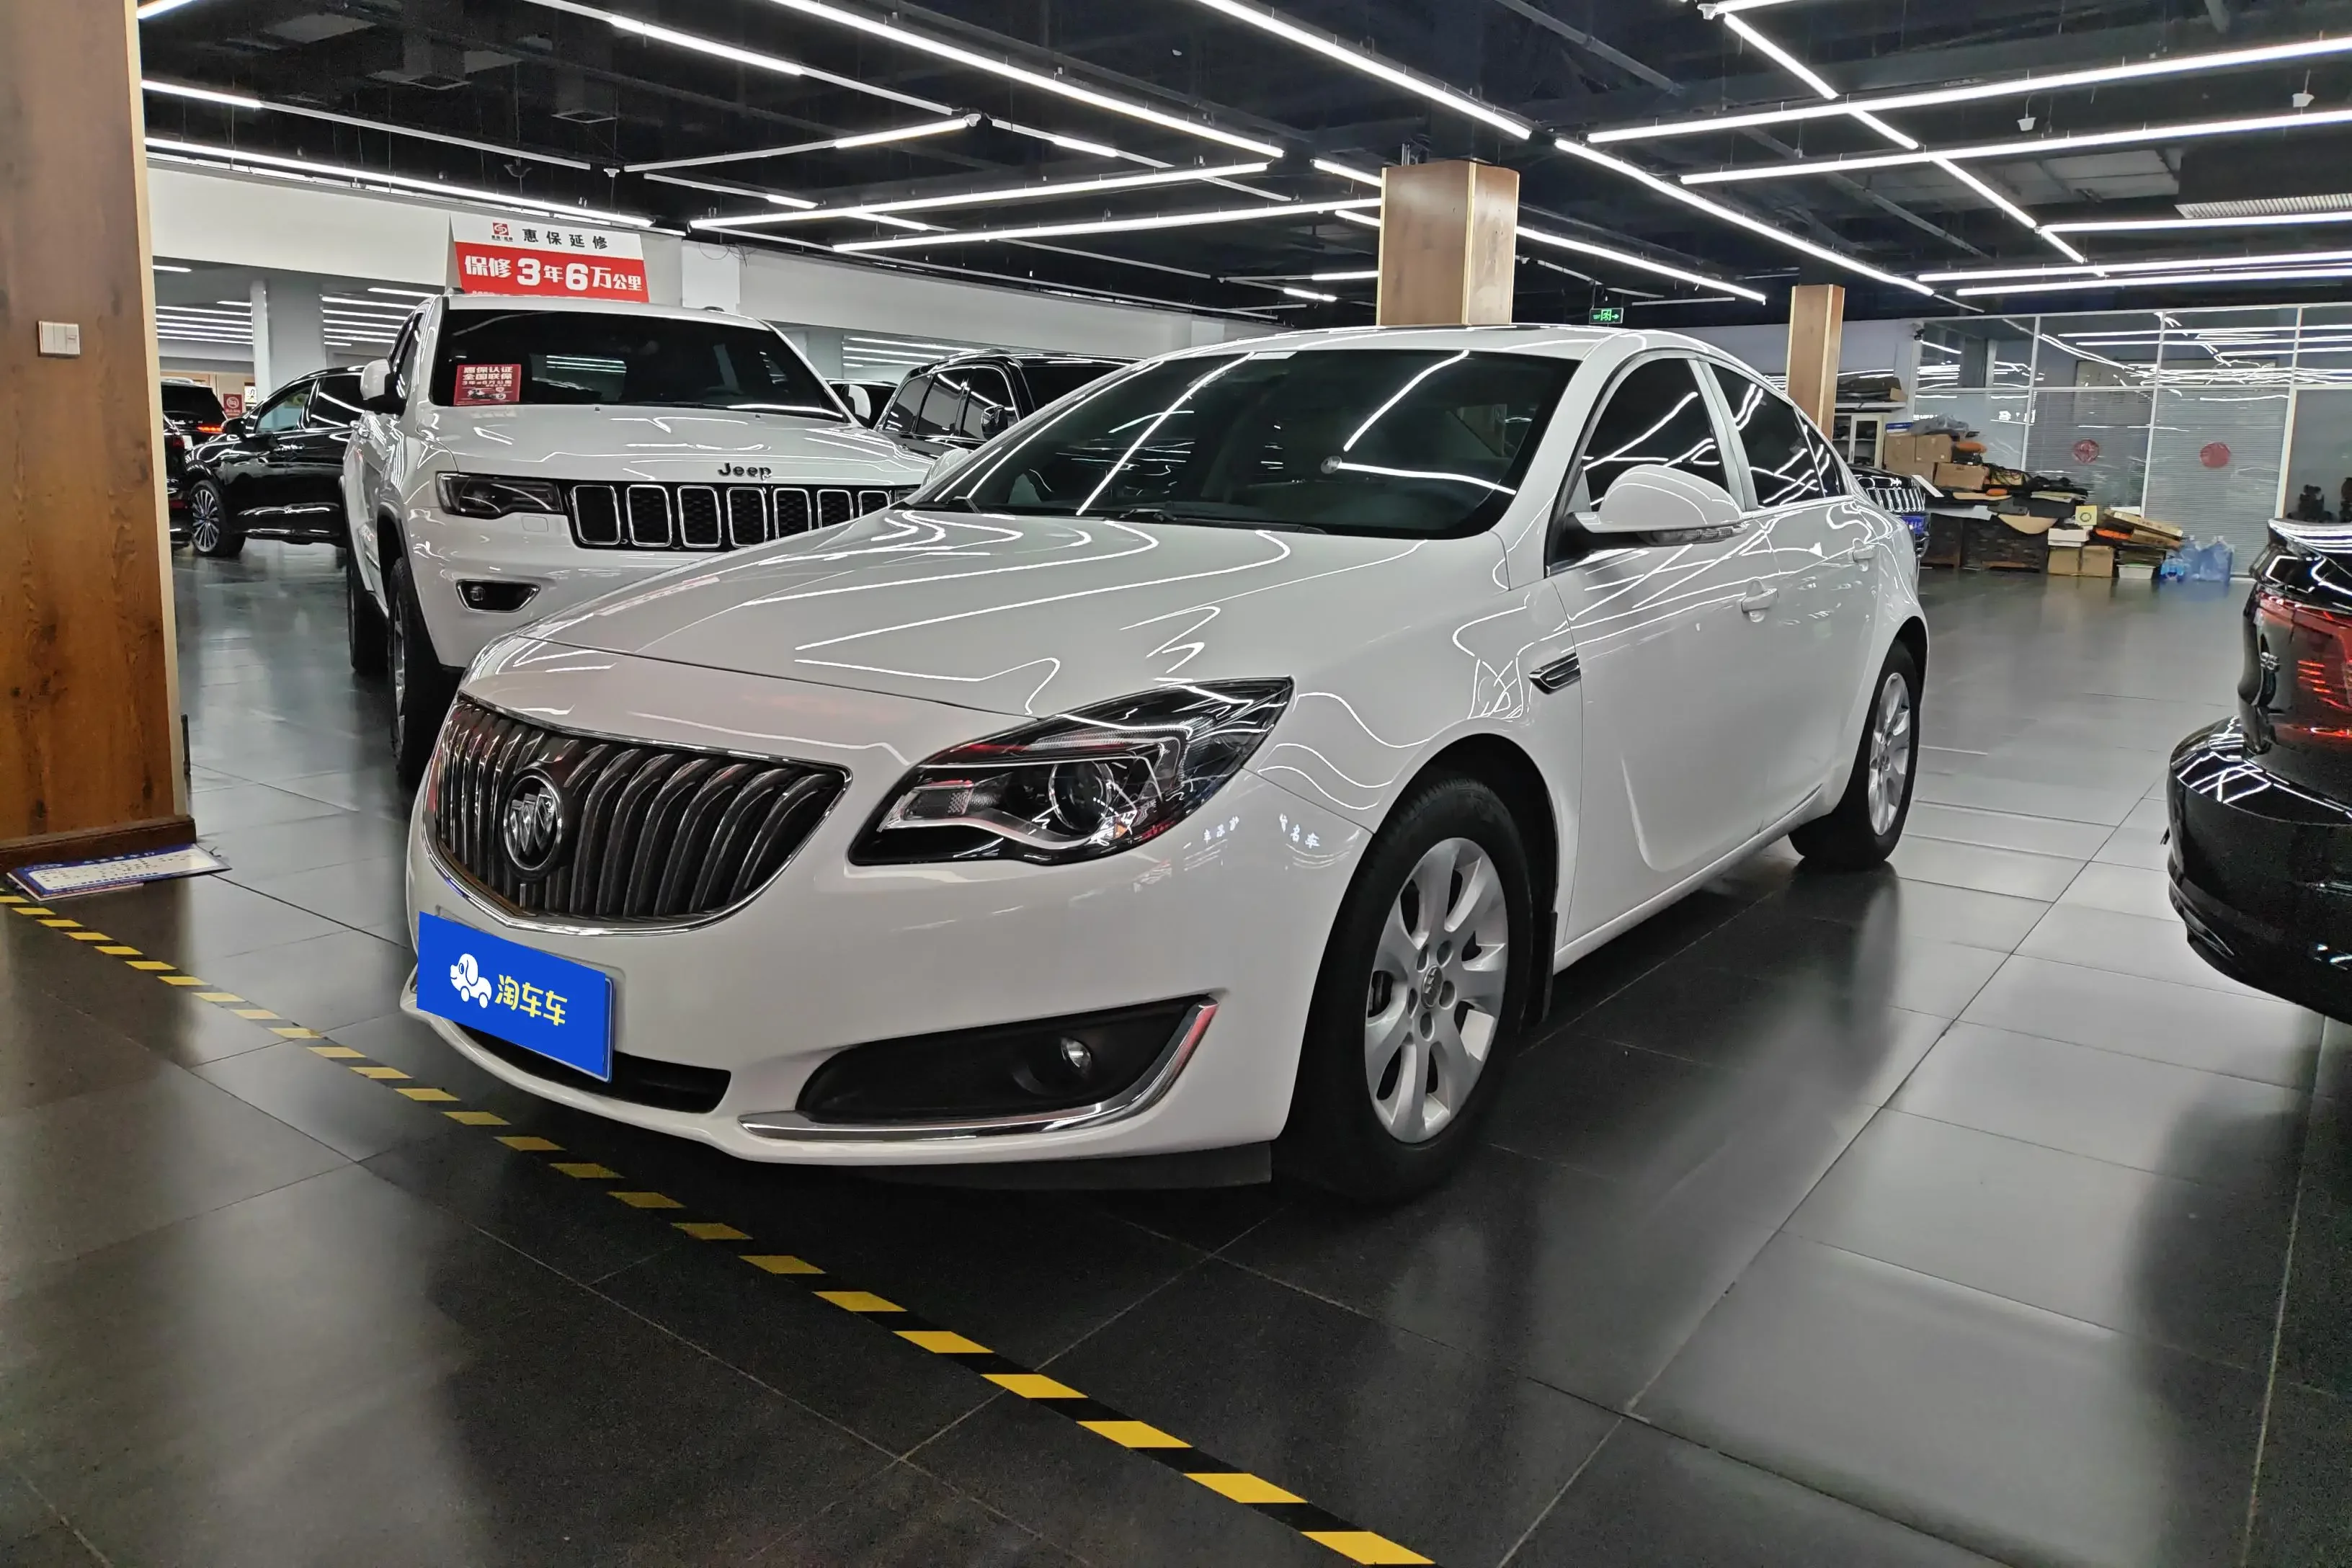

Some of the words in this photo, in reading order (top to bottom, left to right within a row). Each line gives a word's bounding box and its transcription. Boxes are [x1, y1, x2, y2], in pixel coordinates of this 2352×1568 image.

[522, 229, 608, 249] 惠保延修
[465, 255, 642, 291] 保修3年6万公里
[718, 462, 772, 481] Jeep
